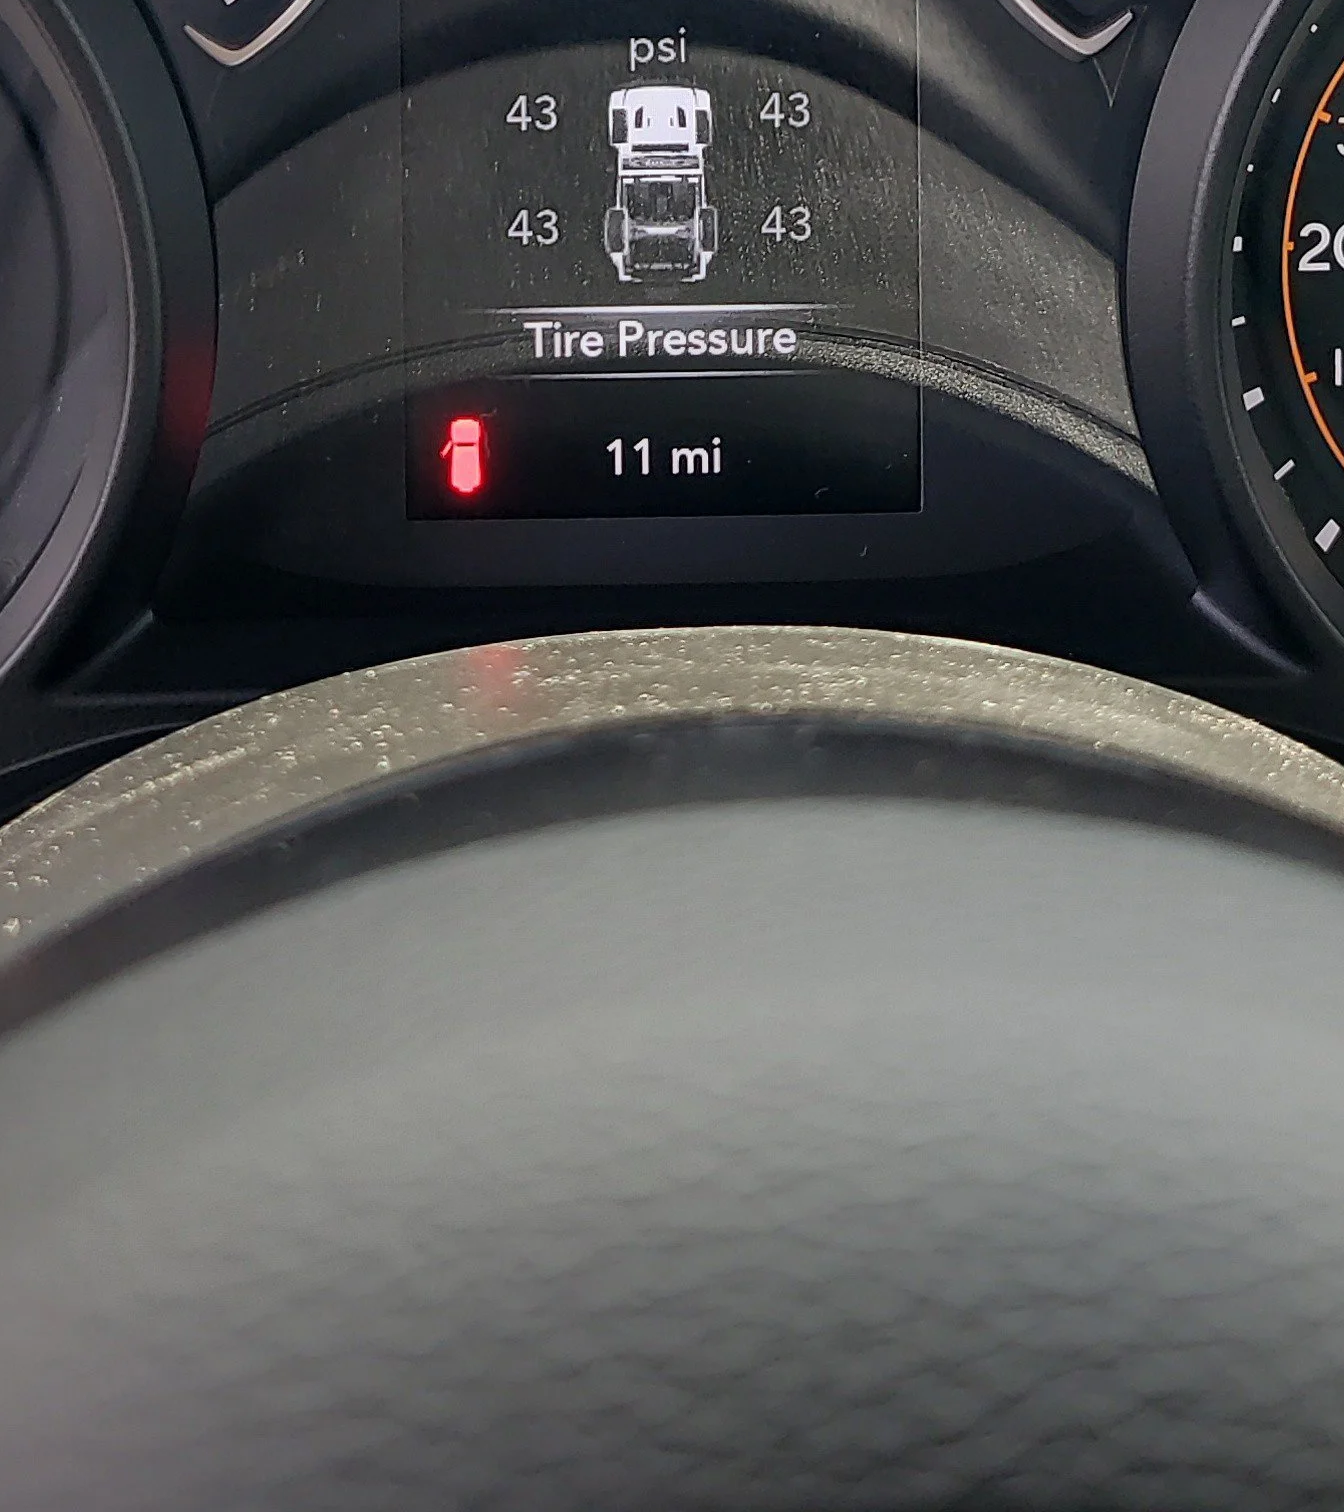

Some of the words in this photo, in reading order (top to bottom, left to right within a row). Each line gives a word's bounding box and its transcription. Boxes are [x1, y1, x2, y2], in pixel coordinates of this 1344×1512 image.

[630, 27, 688, 71] psi
[506, 96, 559, 131] 43
[760, 93, 811, 129] 43
[508, 210, 560, 245] 43
[761, 208, 812, 242] 43
[524, 321, 606, 358] Tire
[618, 321, 797, 358] Pressure
[607, 439, 651, 476] 11
[672, 438, 722, 474] mi
